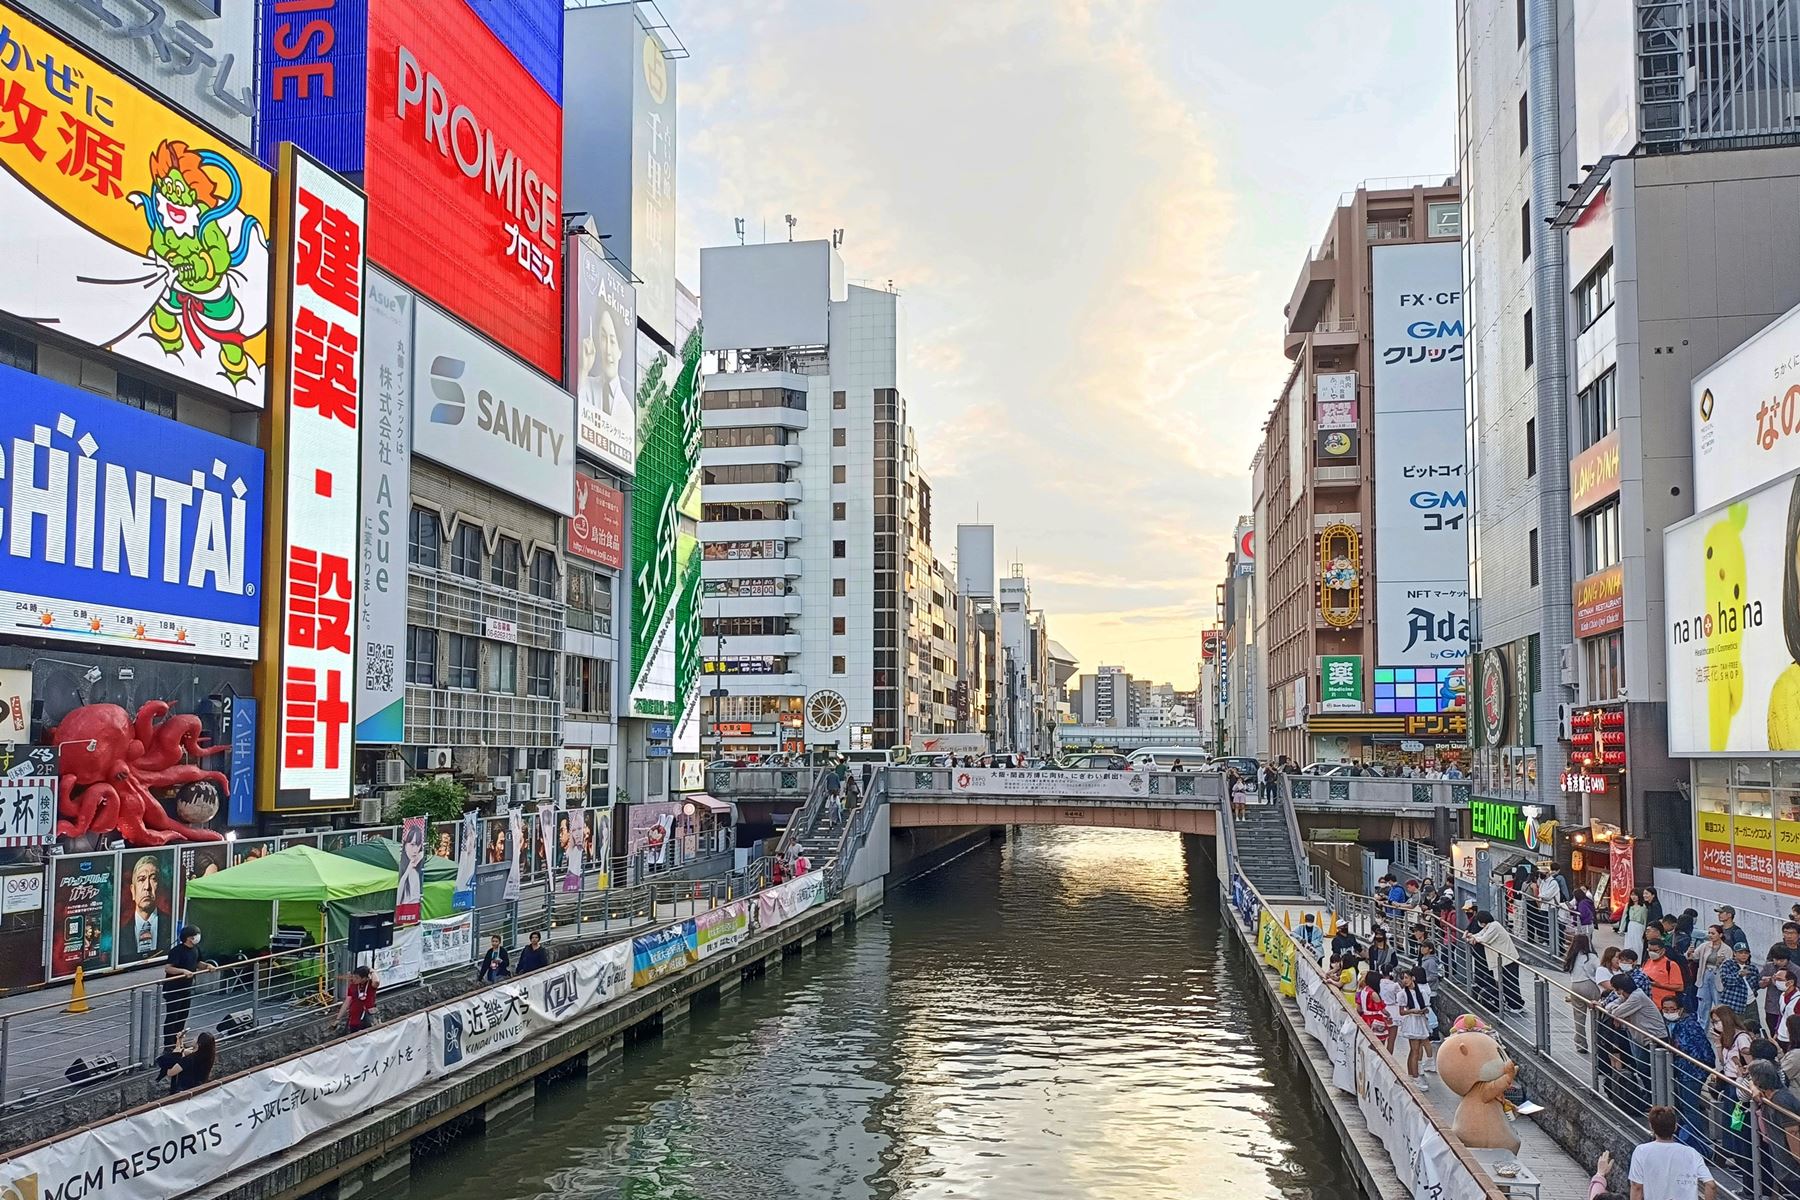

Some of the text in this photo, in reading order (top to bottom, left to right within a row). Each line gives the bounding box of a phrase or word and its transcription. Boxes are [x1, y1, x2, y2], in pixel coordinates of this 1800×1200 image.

[62, 0, 256, 118] ステム
[0, 24, 114, 127] かぜに
[397, 45, 557, 250] PROMISE
[504, 222, 555, 290] プロミス
[369, 284, 397, 313] Asue
[598, 278, 633, 327] Asking!
[1407, 320, 1463, 338] GM
[1383, 344, 1463, 364] クリック
[378, 363, 393, 466] 株式会社
[477, 389, 564, 466] SAMTY
[1403, 464, 1464, 478] ビットコイ
[1574, 444, 1620, 501] LONG DINH
[1409, 490, 1467, 509] GM
[376, 473, 393, 593] Asue
[1423, 513, 1464, 531] コイ
[1407, 590, 1432, 598] NFT
[1577, 573, 1622, 608] LONG DINH
[16, 602, 38, 612] 24時
[73, 609, 88, 619] 6時
[1595, 596, 1622, 613] RESTAURANT
[116, 615, 134, 625] 12時
[159, 620, 176, 631] 18時
[220, 631, 250, 650] 18 12
[1430, 649, 1468, 660] by GM
[1329, 661, 1354, 685] 薬
[222, 697, 231, 733] 2F
[37, 764, 55, 776] 2F
[40, 795, 51, 825] 検索
[1485, 803, 1516, 840] MART
[1734, 825, 1772, 840] オーガニックコスメ
[1703, 847, 1732, 867] メイクを自
[1736, 852, 1773, 874] 由に試せる
[466, 1018, 532, 1055] KINDAI UNIVERSITY
[45, 1122, 222, 1200] MGM RESORTS
